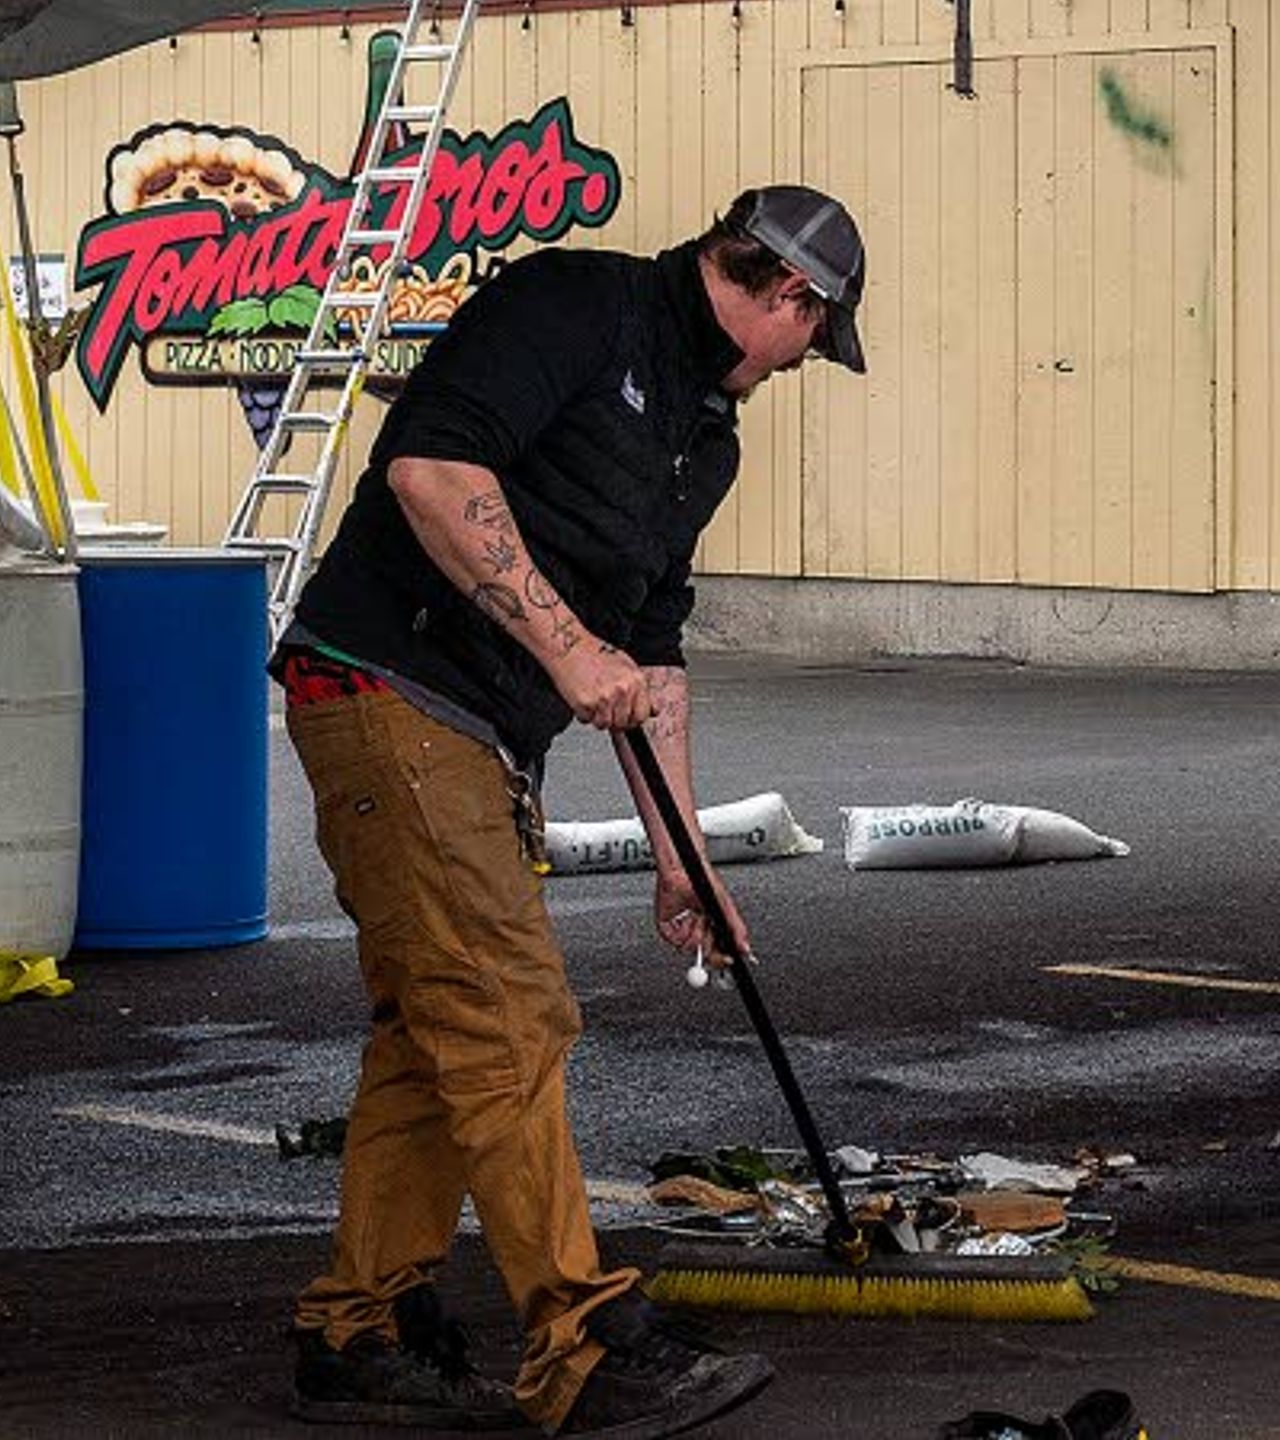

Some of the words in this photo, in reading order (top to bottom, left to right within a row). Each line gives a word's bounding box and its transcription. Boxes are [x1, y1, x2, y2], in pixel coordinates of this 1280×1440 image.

[83, 187, 368, 379] Tomato
[373, 119, 605, 262] Bros.
[165, 341, 222, 373] PIZZA
